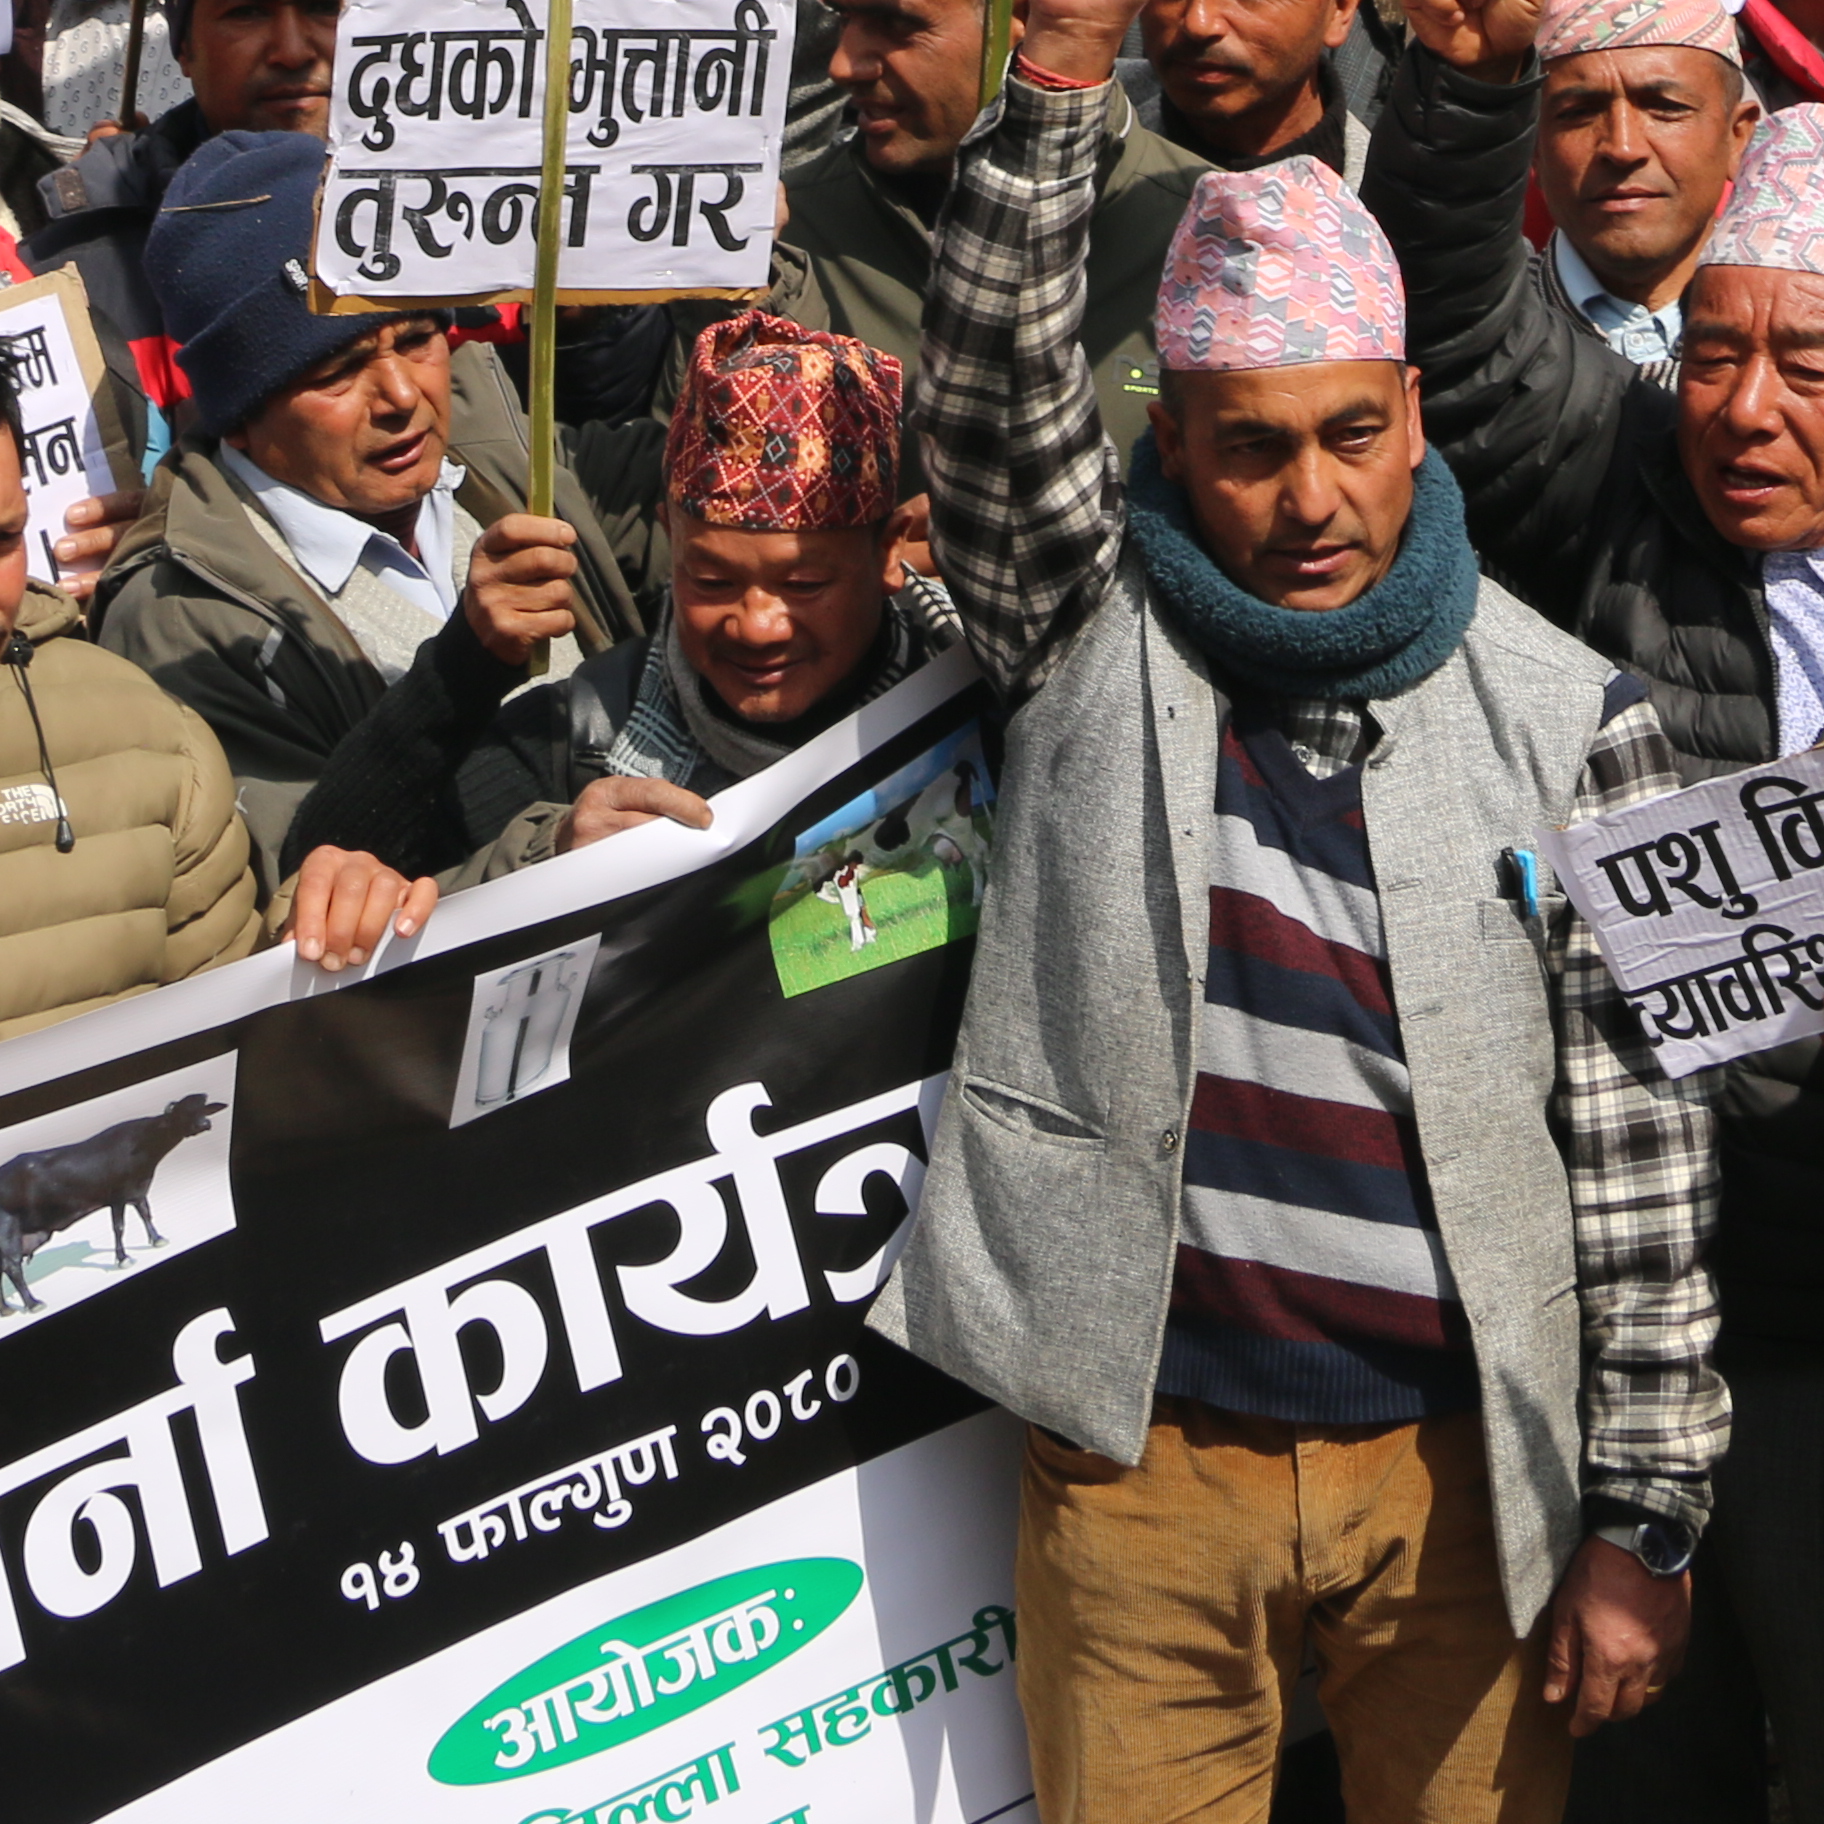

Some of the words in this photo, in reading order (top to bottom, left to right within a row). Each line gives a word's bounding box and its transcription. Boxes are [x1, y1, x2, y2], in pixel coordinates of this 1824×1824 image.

[627, 163, 763, 252] गर
[0, 785, 32, 801] THE
[1595, 819, 1760, 921] पशु
[340, 1540, 422, 1612] १४
[699, 1352, 862, 1467] २०८०
